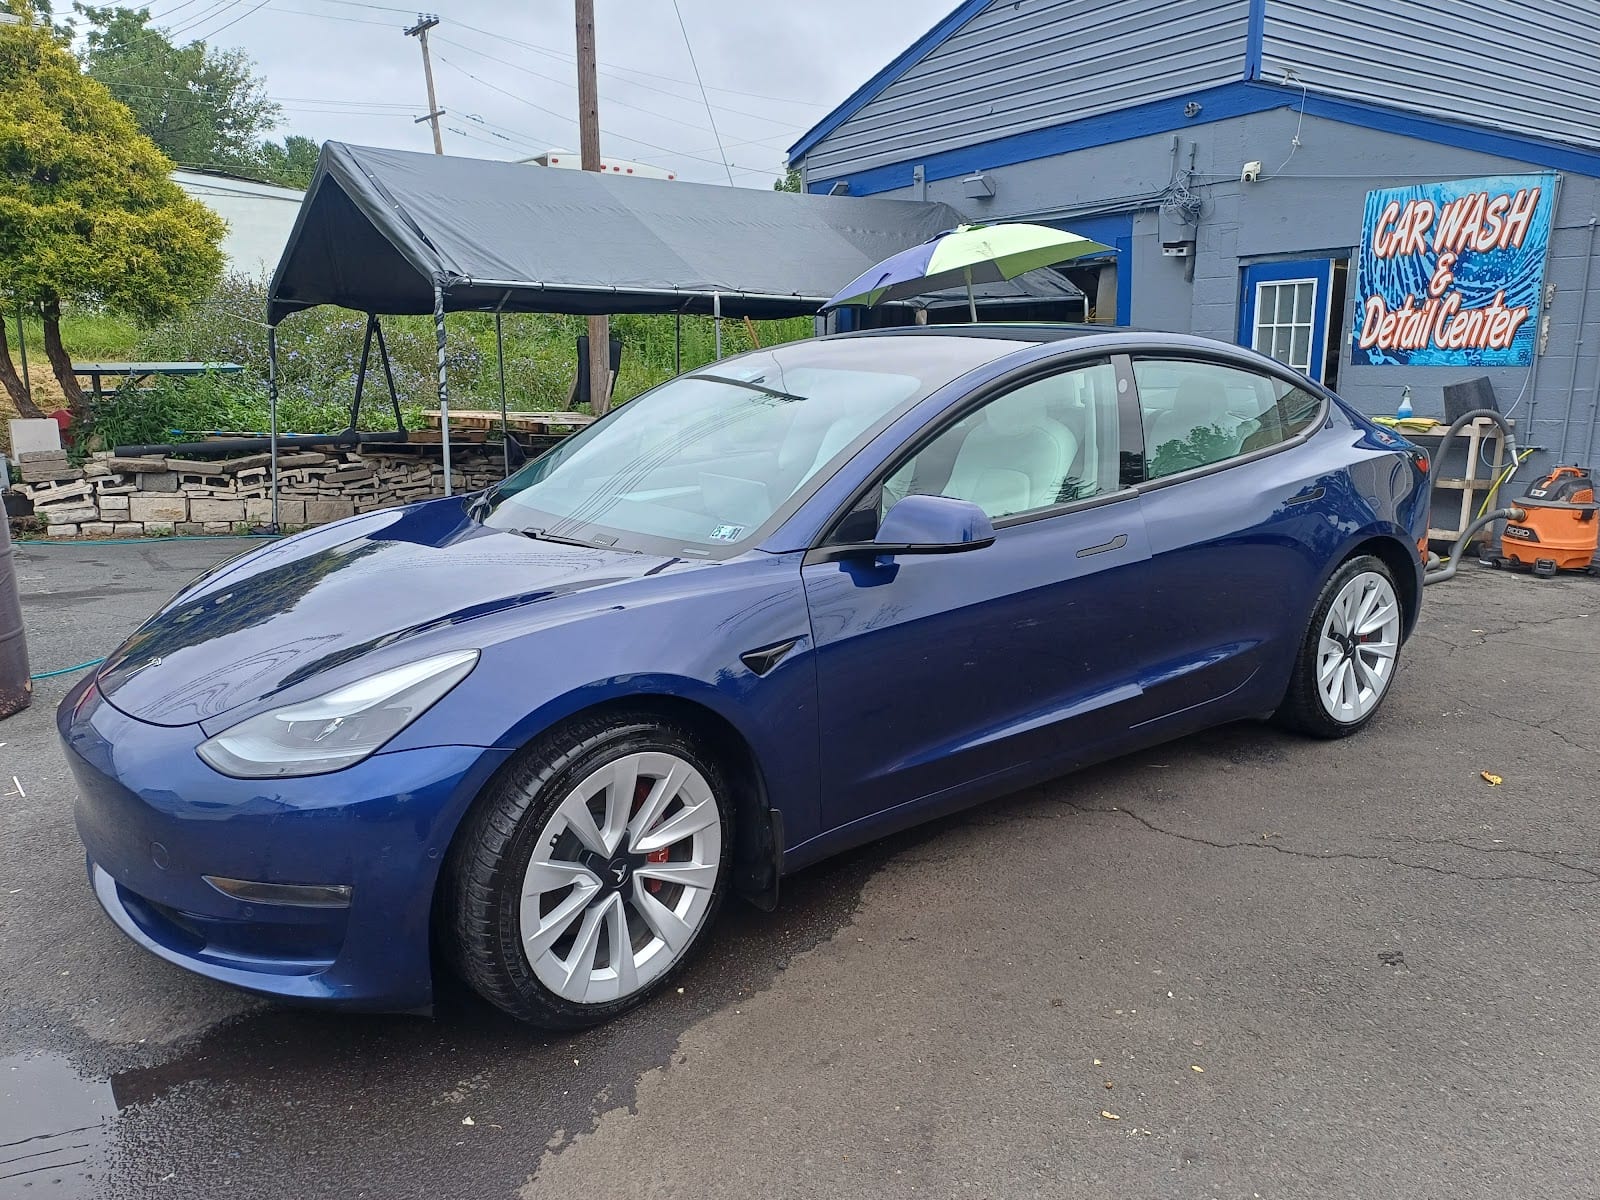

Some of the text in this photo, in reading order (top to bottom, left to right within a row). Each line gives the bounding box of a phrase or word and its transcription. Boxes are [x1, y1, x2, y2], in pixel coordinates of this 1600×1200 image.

[1373, 188, 1541, 258] CAR WASH
[1429, 251, 1456, 297] &
[1359, 290, 1528, 349] Detail Center
